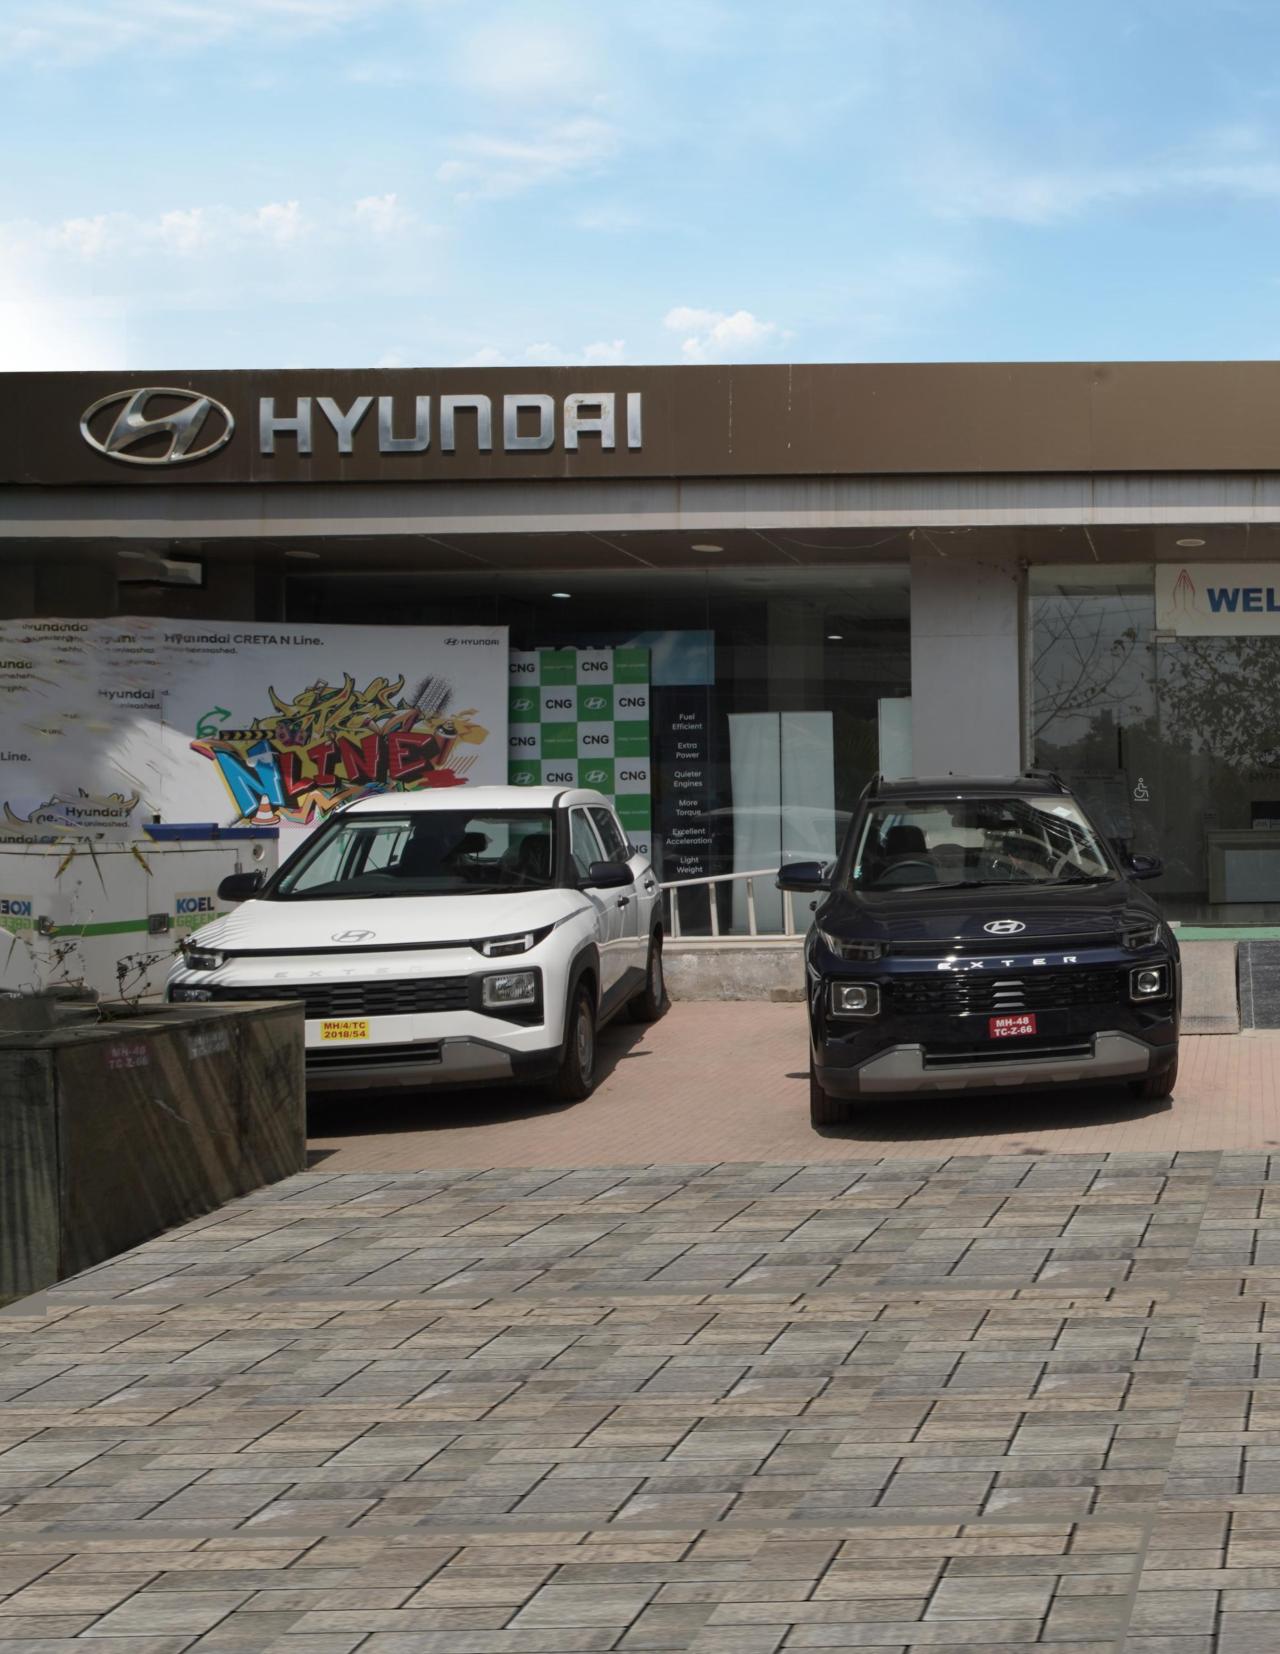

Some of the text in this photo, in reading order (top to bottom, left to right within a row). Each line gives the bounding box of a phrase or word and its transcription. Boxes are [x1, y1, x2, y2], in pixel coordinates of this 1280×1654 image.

[258, 392, 642, 454] HYUNDAI
[233, 634, 277, 645] CRETA
[280, 635, 290, 645] N
[294, 636, 325, 646] Line.
[509, 663, 536, 673] CNG
[582, 661, 609, 672] CNG
[545, 699, 573, 710] CNG
[618, 697, 646, 708] CNG
[680, 713, 696, 721] Fuel
[672, 723, 704, 731] Efficient
[509, 736, 537, 747] CNG
[583, 735, 610, 745] CNG
[677, 742, 698, 750] Extra
[546, 773, 574, 783] CNG
[620, 771, 647, 781] CNG
[674, 770, 702, 779] Quieter
[673, 781, 703, 789] Engines
[676, 809, 701, 817] Torque
[672, 828, 706, 836] Excellent
[666, 838, 712, 846] Acceleration
[680, 856, 699, 864] Light
[176, 896, 215, 913] KOEL
[938, 956, 1077, 971] EXTER
[996, 1016, 1029, 1027] MH-48
[993, 1025, 1033, 1037] TC-Z-66
